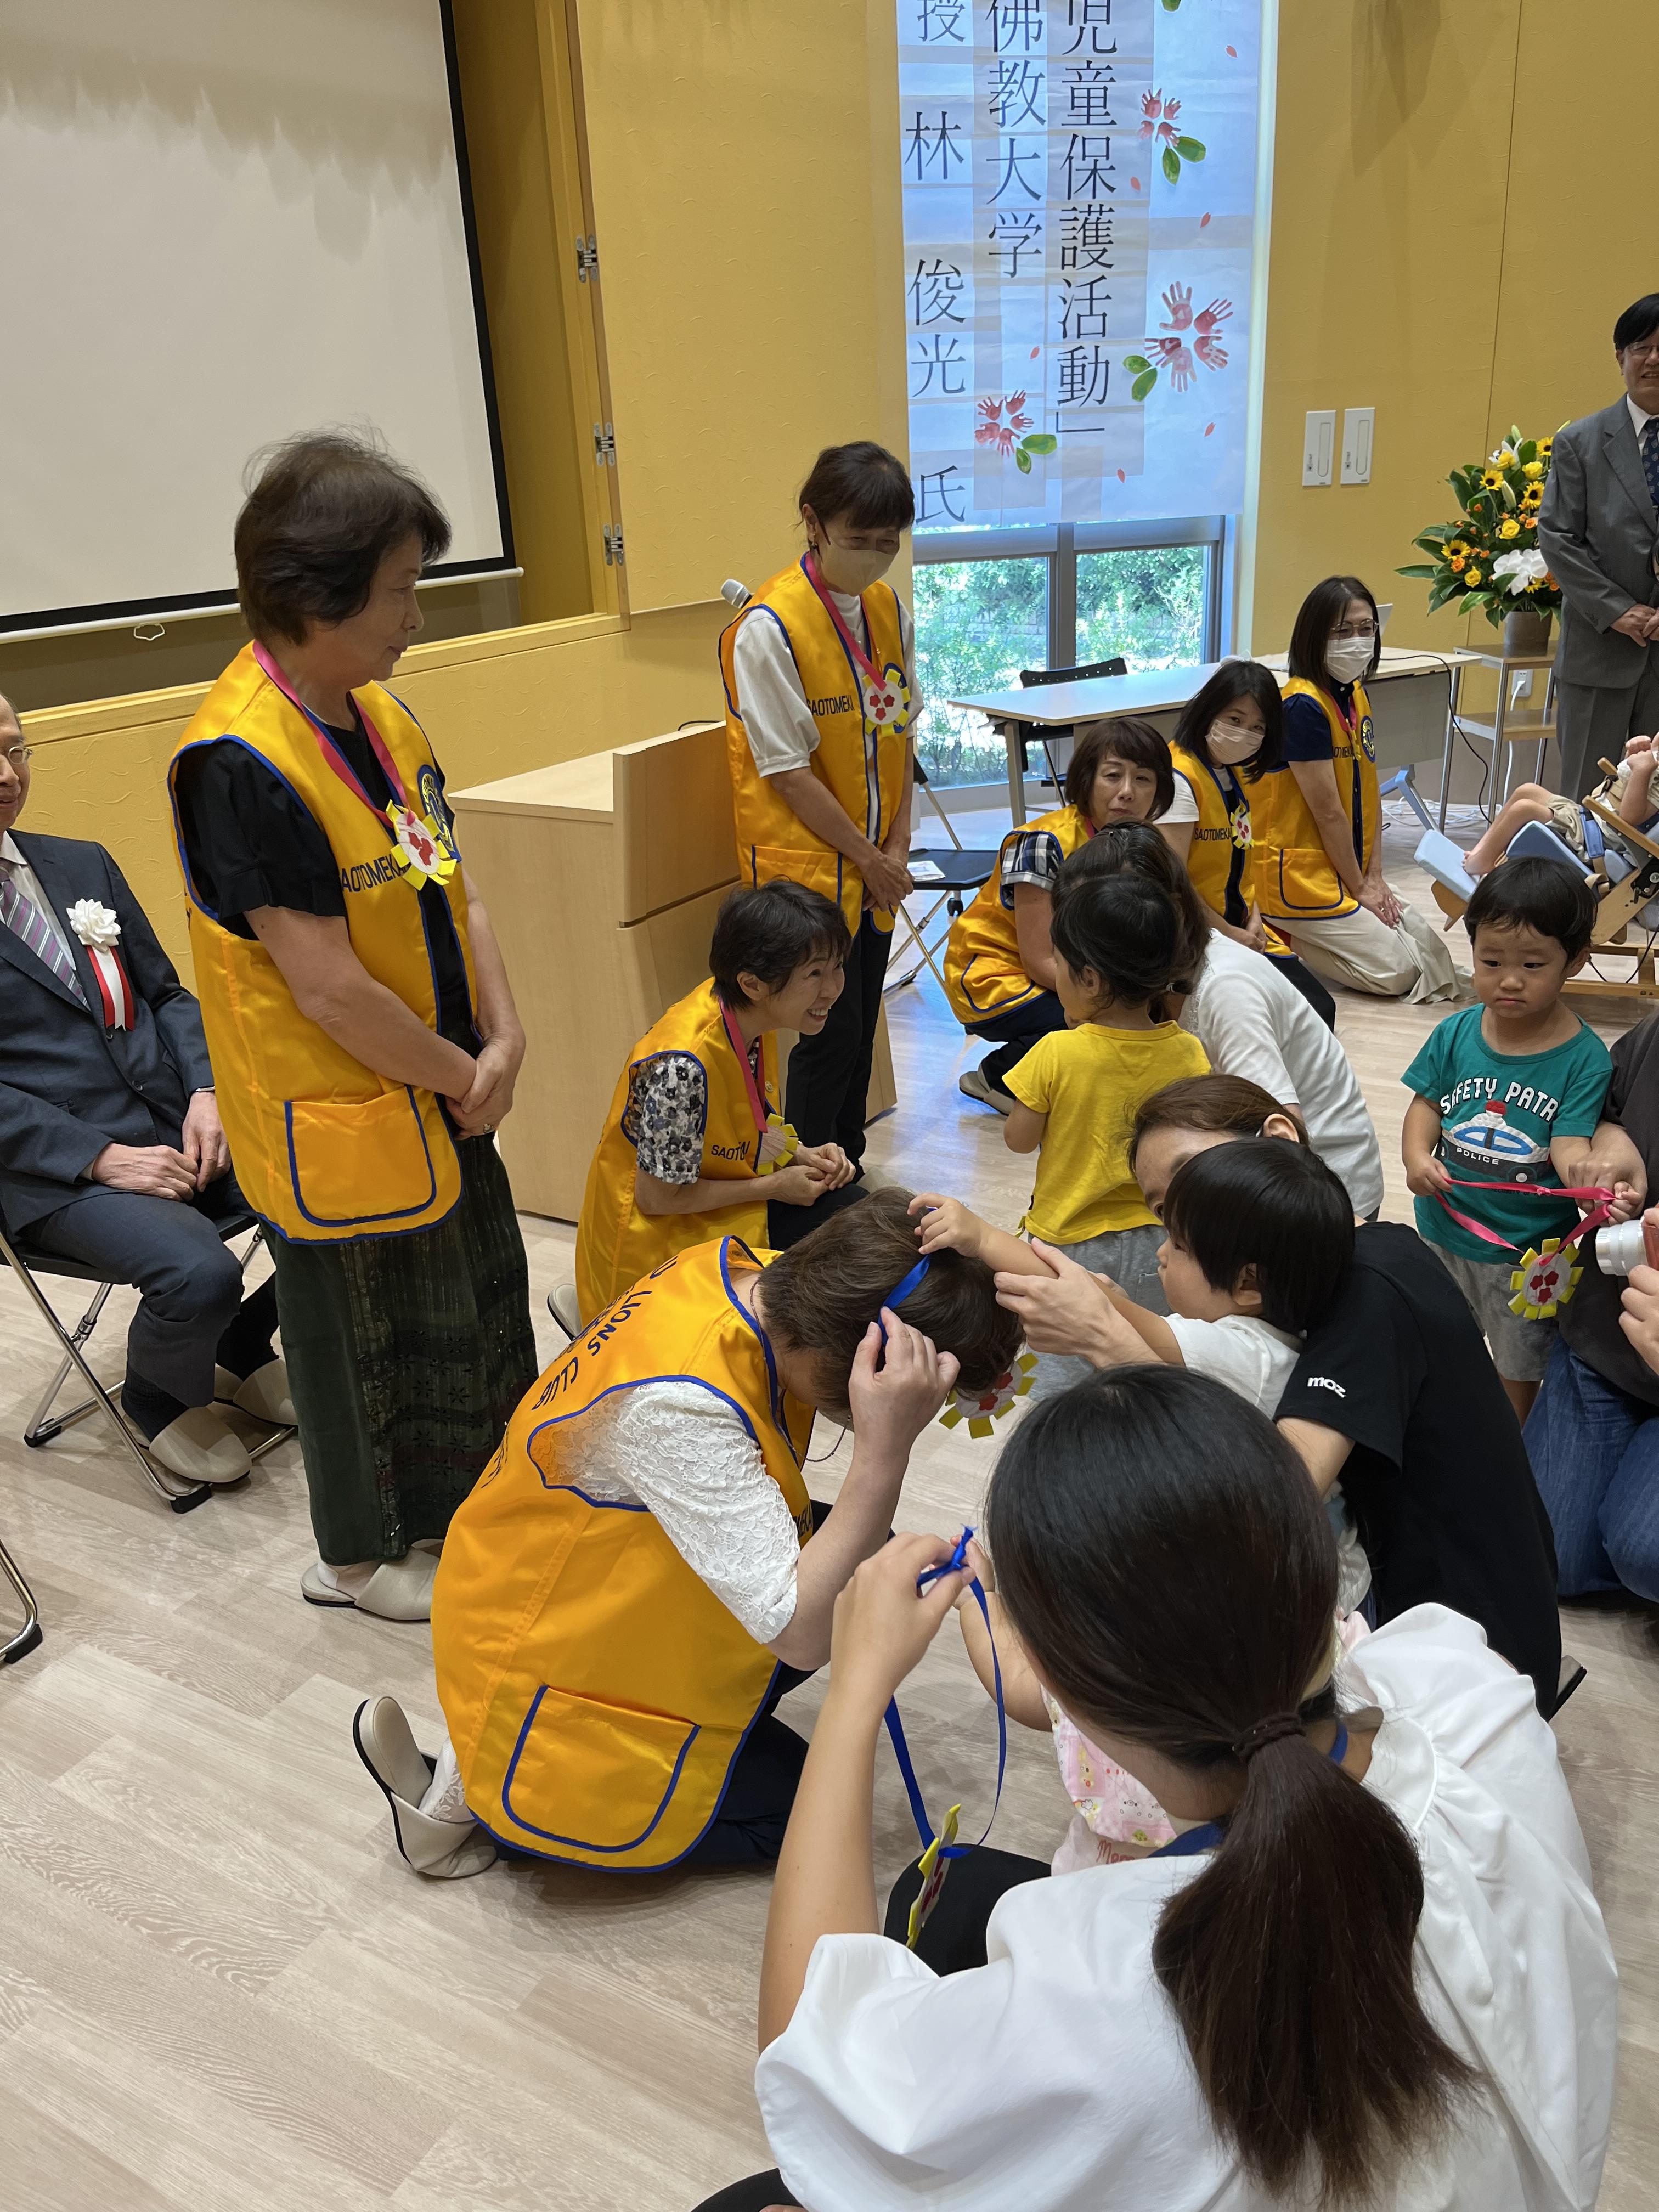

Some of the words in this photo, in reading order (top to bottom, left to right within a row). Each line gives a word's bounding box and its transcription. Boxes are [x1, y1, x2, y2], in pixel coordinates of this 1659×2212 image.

[905, 111, 964, 181] 林
[915, 465, 966, 525] 氏
[1457, 1147, 1500, 1165] POLICE
[587, 1290, 653, 1356] LIONS
[531, 1356, 578, 1411] CLUB
